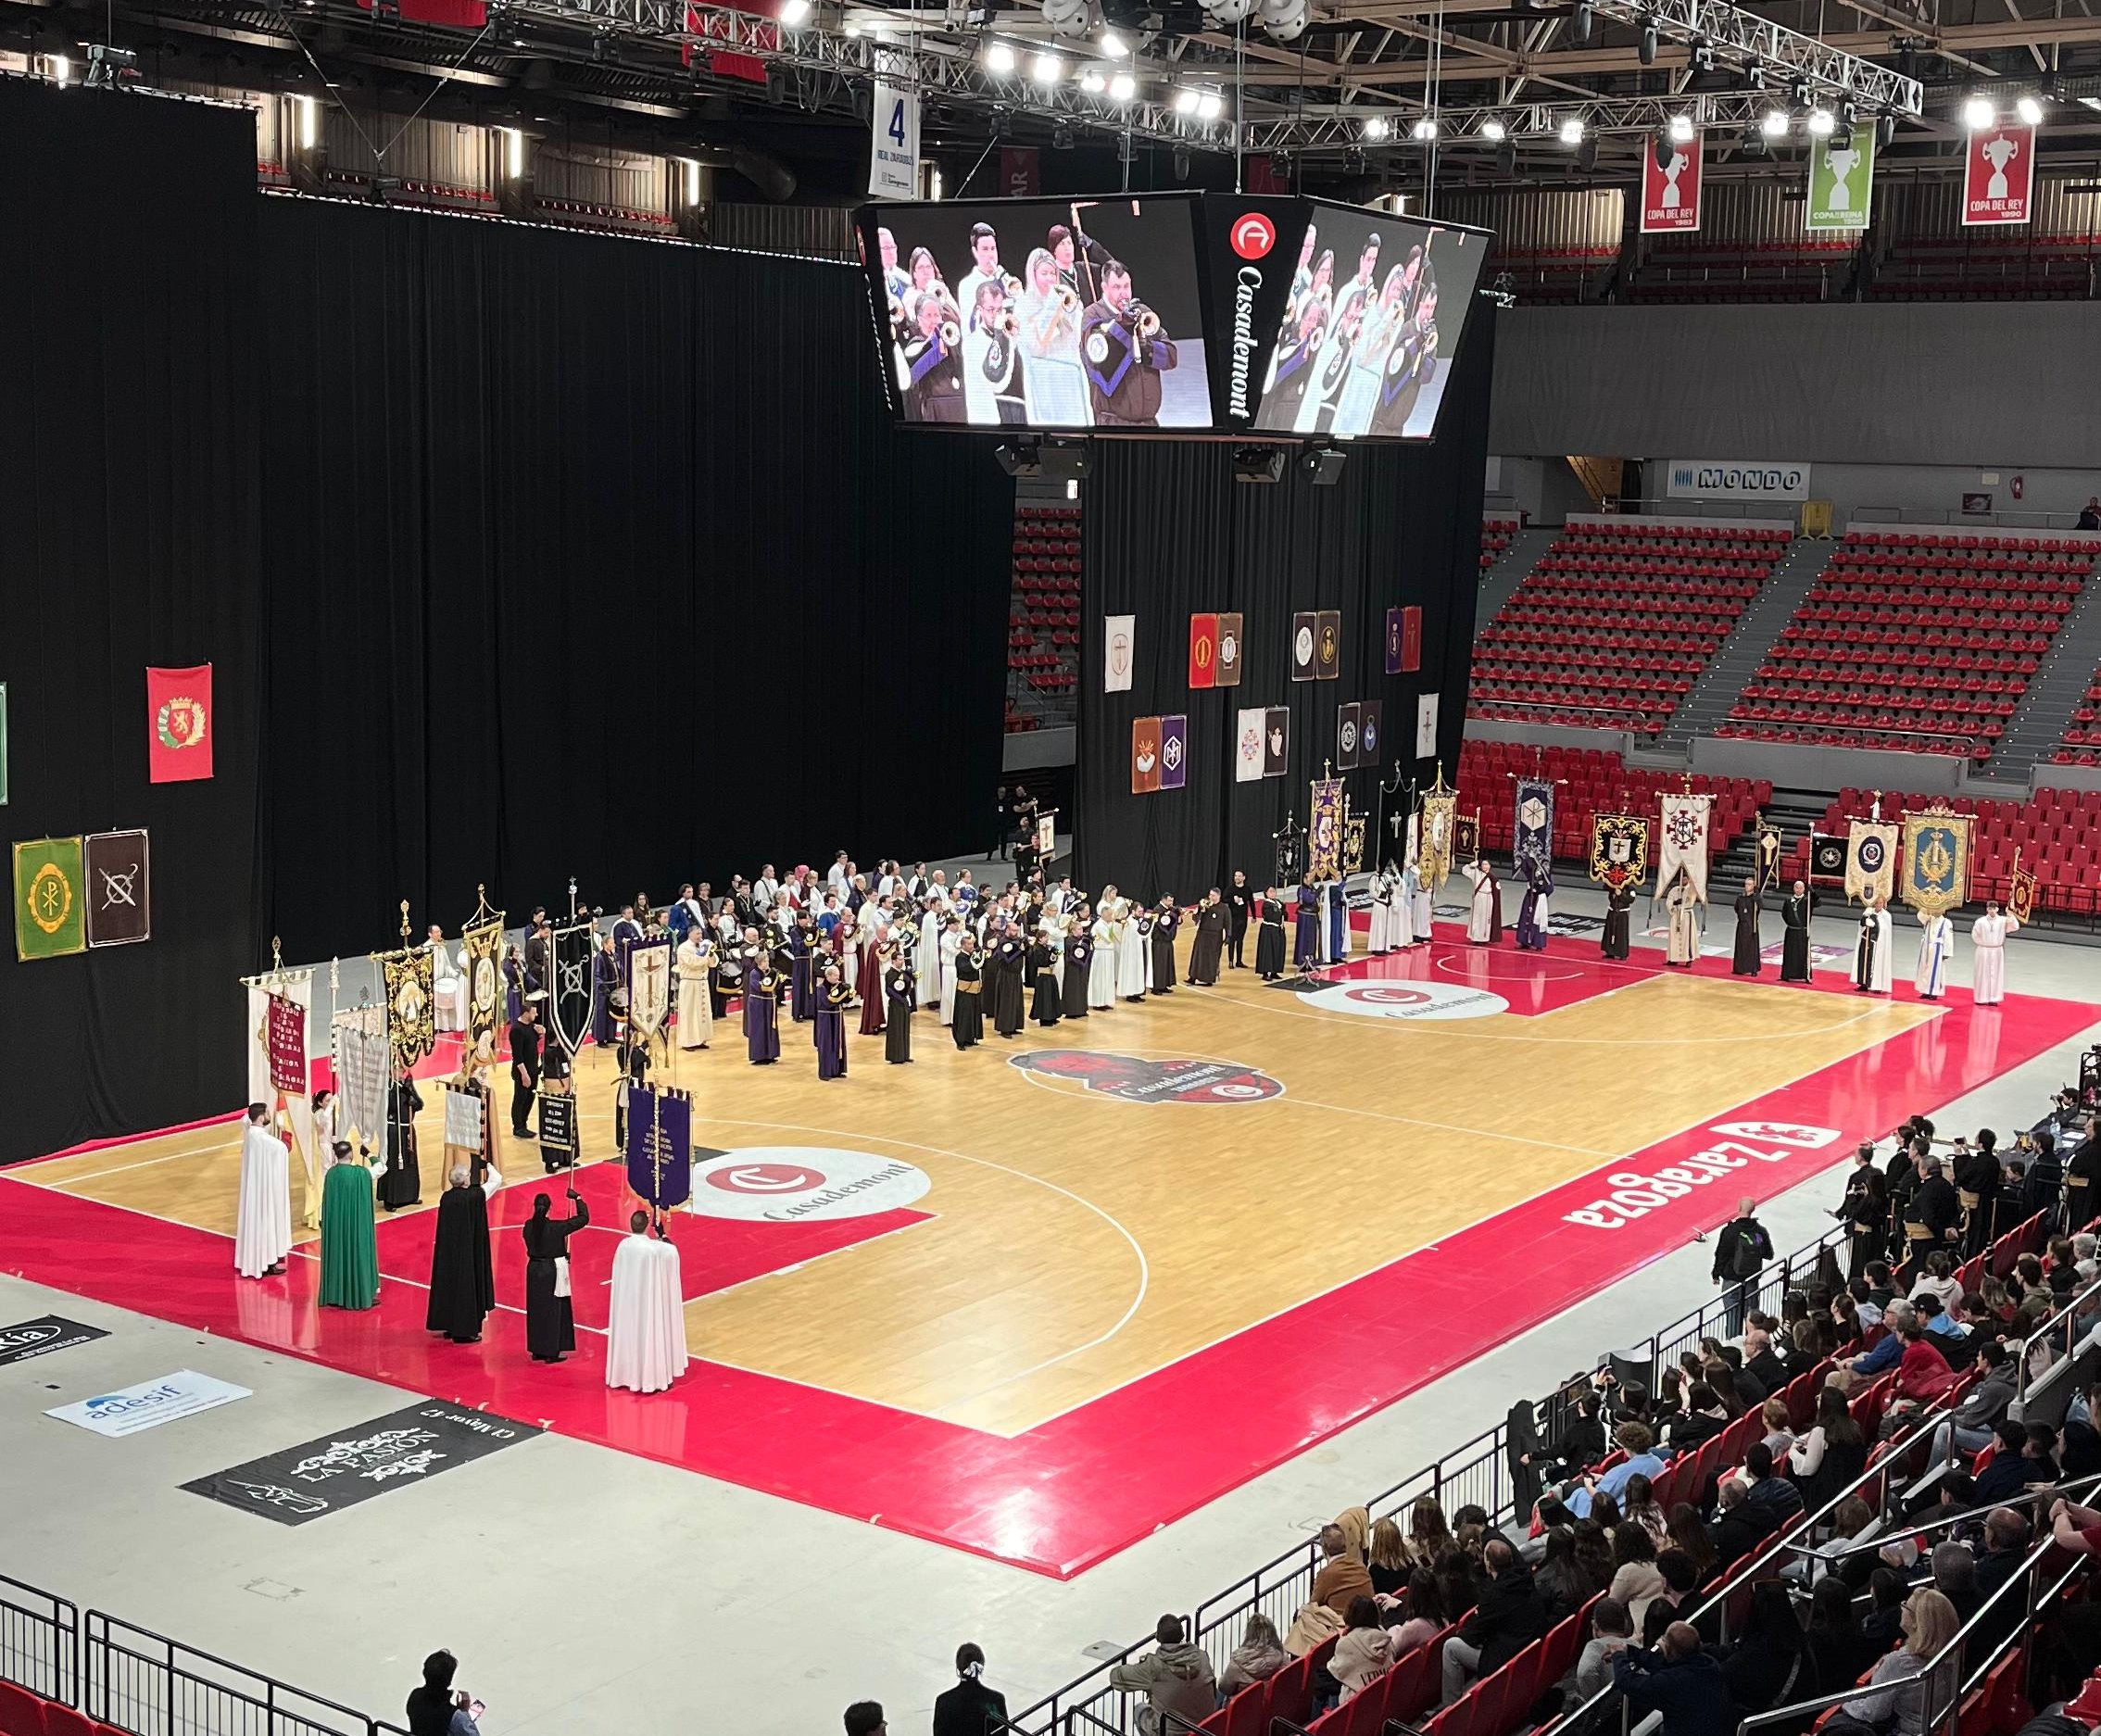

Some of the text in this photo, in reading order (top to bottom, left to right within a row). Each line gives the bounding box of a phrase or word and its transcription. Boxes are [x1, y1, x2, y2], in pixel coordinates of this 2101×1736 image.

[888, 98, 905, 147] 4
[1648, 208, 1693, 220] COPA DEL REY
[1813, 211, 1834, 220] COPA
[1970, 198, 2023, 211] COPA DEL REY
[1230, 266, 1263, 420] Casademont
[1698, 469, 1802, 490] MONDO
[763, 1163, 915, 1221] Casademont
[1561, 1141, 1792, 1228] Zaragoza
[85, 1385, 182, 1419] adesif
[297, 1466, 345, 1482] LA
